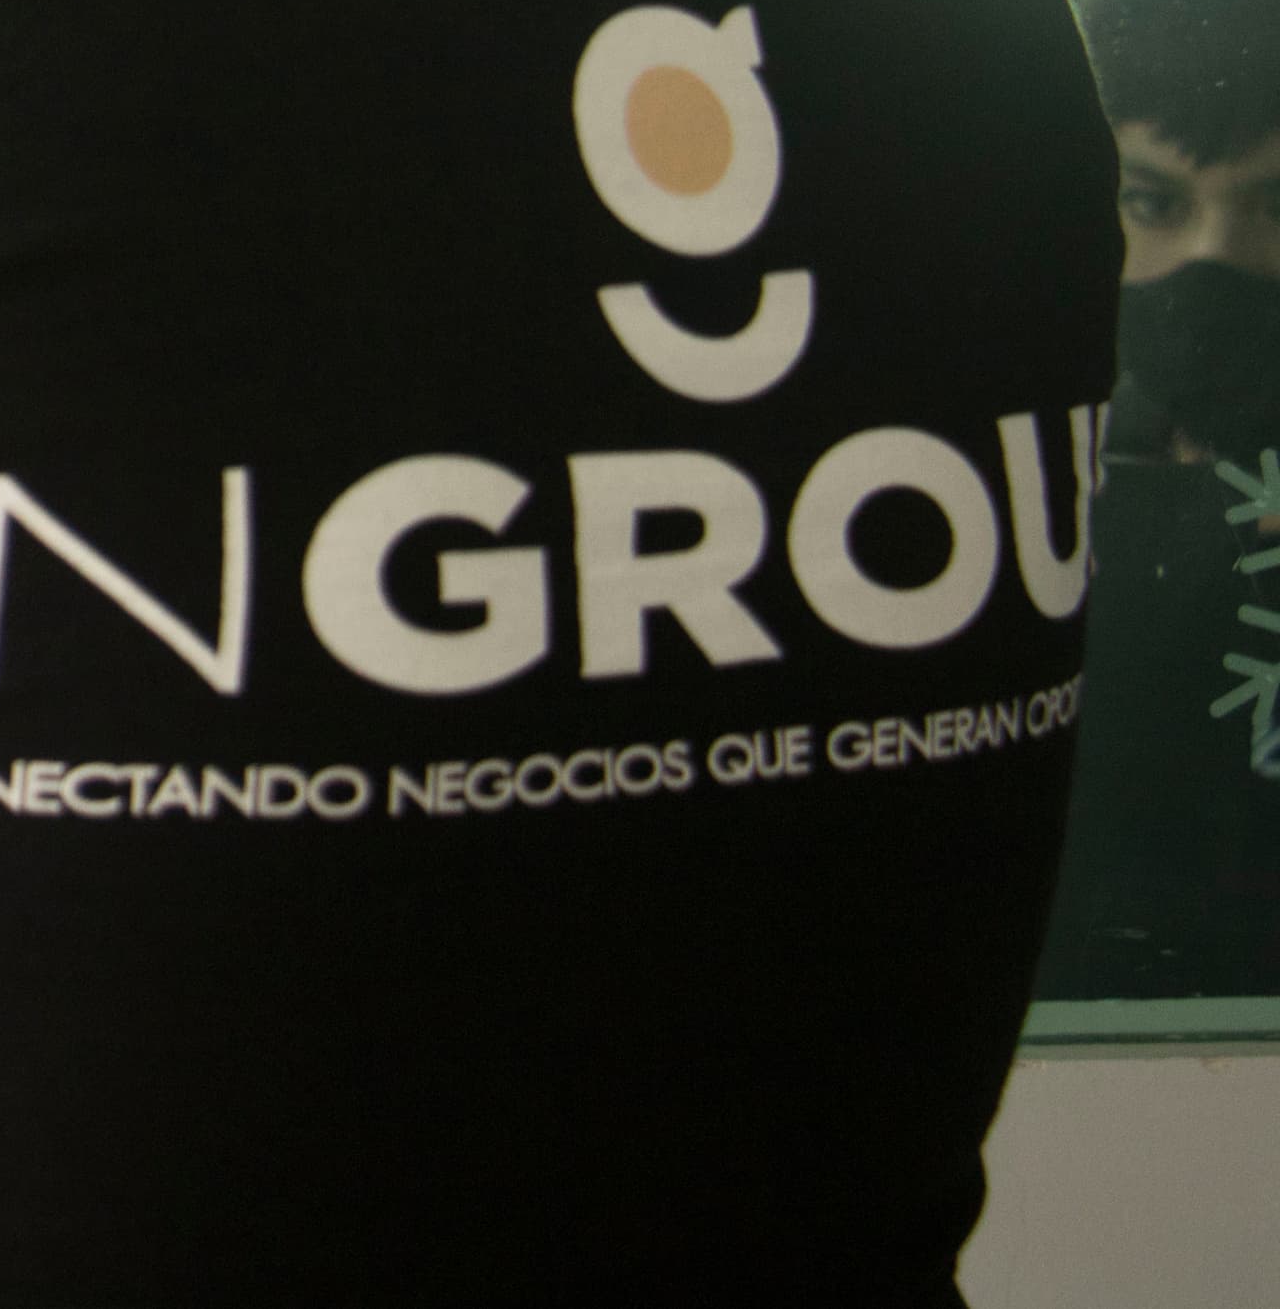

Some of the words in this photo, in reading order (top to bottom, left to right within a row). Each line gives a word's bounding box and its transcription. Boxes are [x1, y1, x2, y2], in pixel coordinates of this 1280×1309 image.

[387, 739, 695, 817] NEGOCIOS
[707, 724, 811, 784] QUE
[827, 696, 1020, 771] GENERAN
